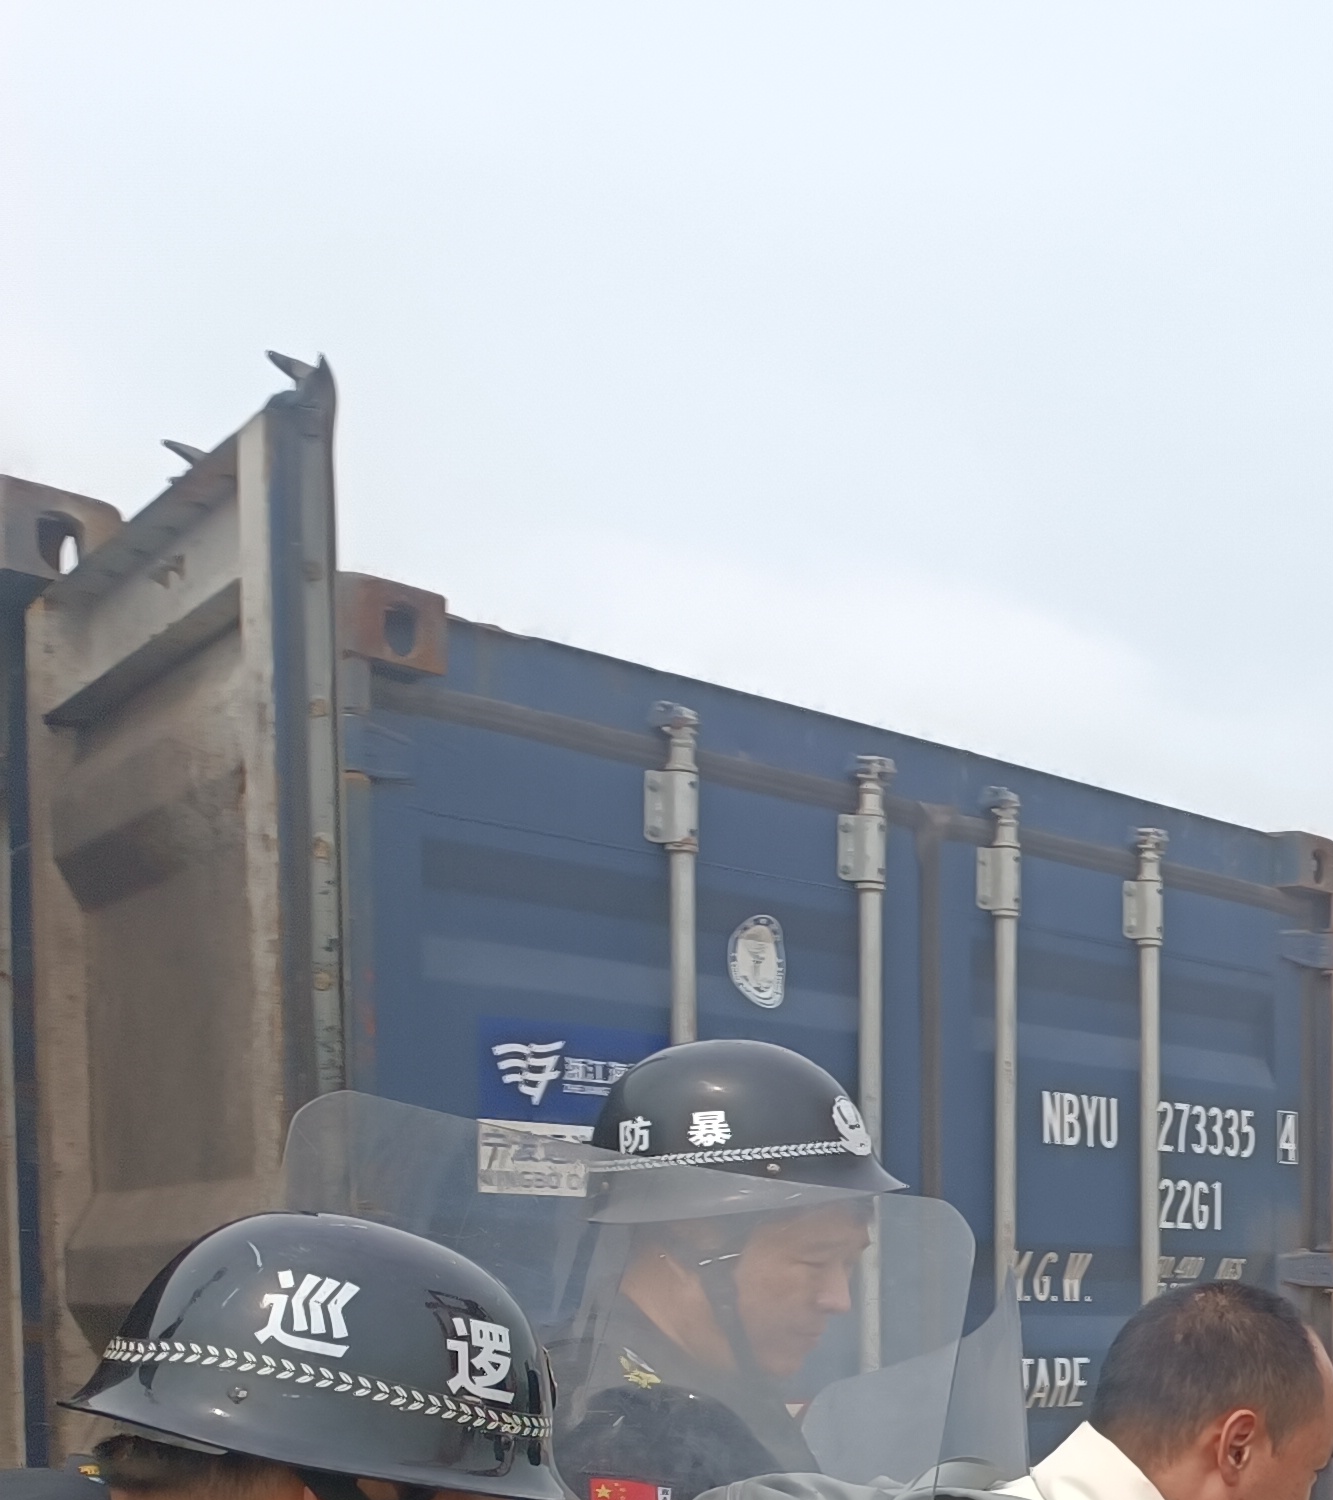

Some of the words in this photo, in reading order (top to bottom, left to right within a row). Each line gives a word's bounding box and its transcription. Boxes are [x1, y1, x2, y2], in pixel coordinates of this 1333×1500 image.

[618, 1110, 733, 1154] 防暴
[1042, 1091, 1118, 1149] NBYU
[1156, 1101, 1256, 1159] 273335
[1277, 1111, 1298, 1164] 4
[1158, 1178, 1222, 1230] 22G1
[254, 1269, 515, 1404] 巡逻
[1022, 1356, 1091, 1409] TARE
